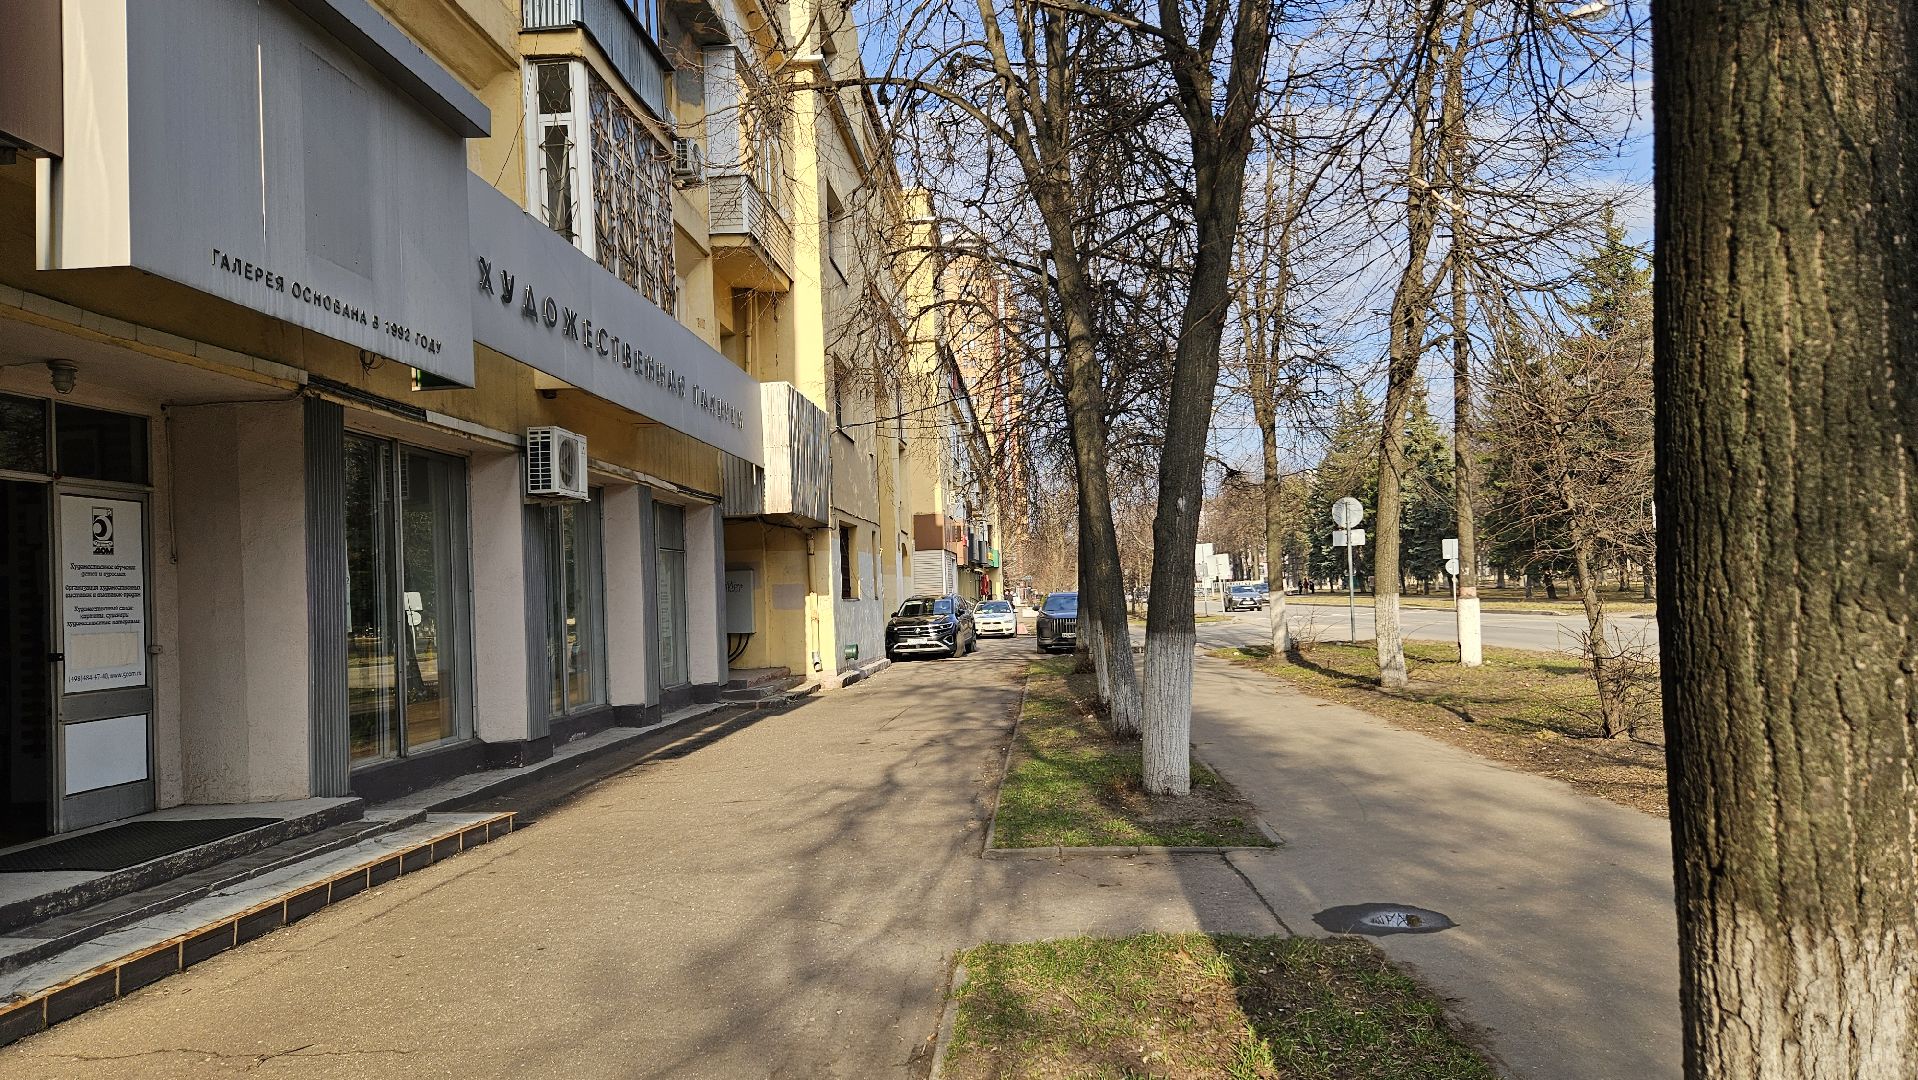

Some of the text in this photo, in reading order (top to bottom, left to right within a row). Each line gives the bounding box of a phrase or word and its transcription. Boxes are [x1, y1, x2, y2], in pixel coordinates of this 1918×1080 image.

[211, 248, 442, 355] ГАЛЕРЕЯ ОСНОВАНА В 1992 ГОДУ
[477, 255, 687, 398] ХУДОЖЕСТВЕННАЯ
